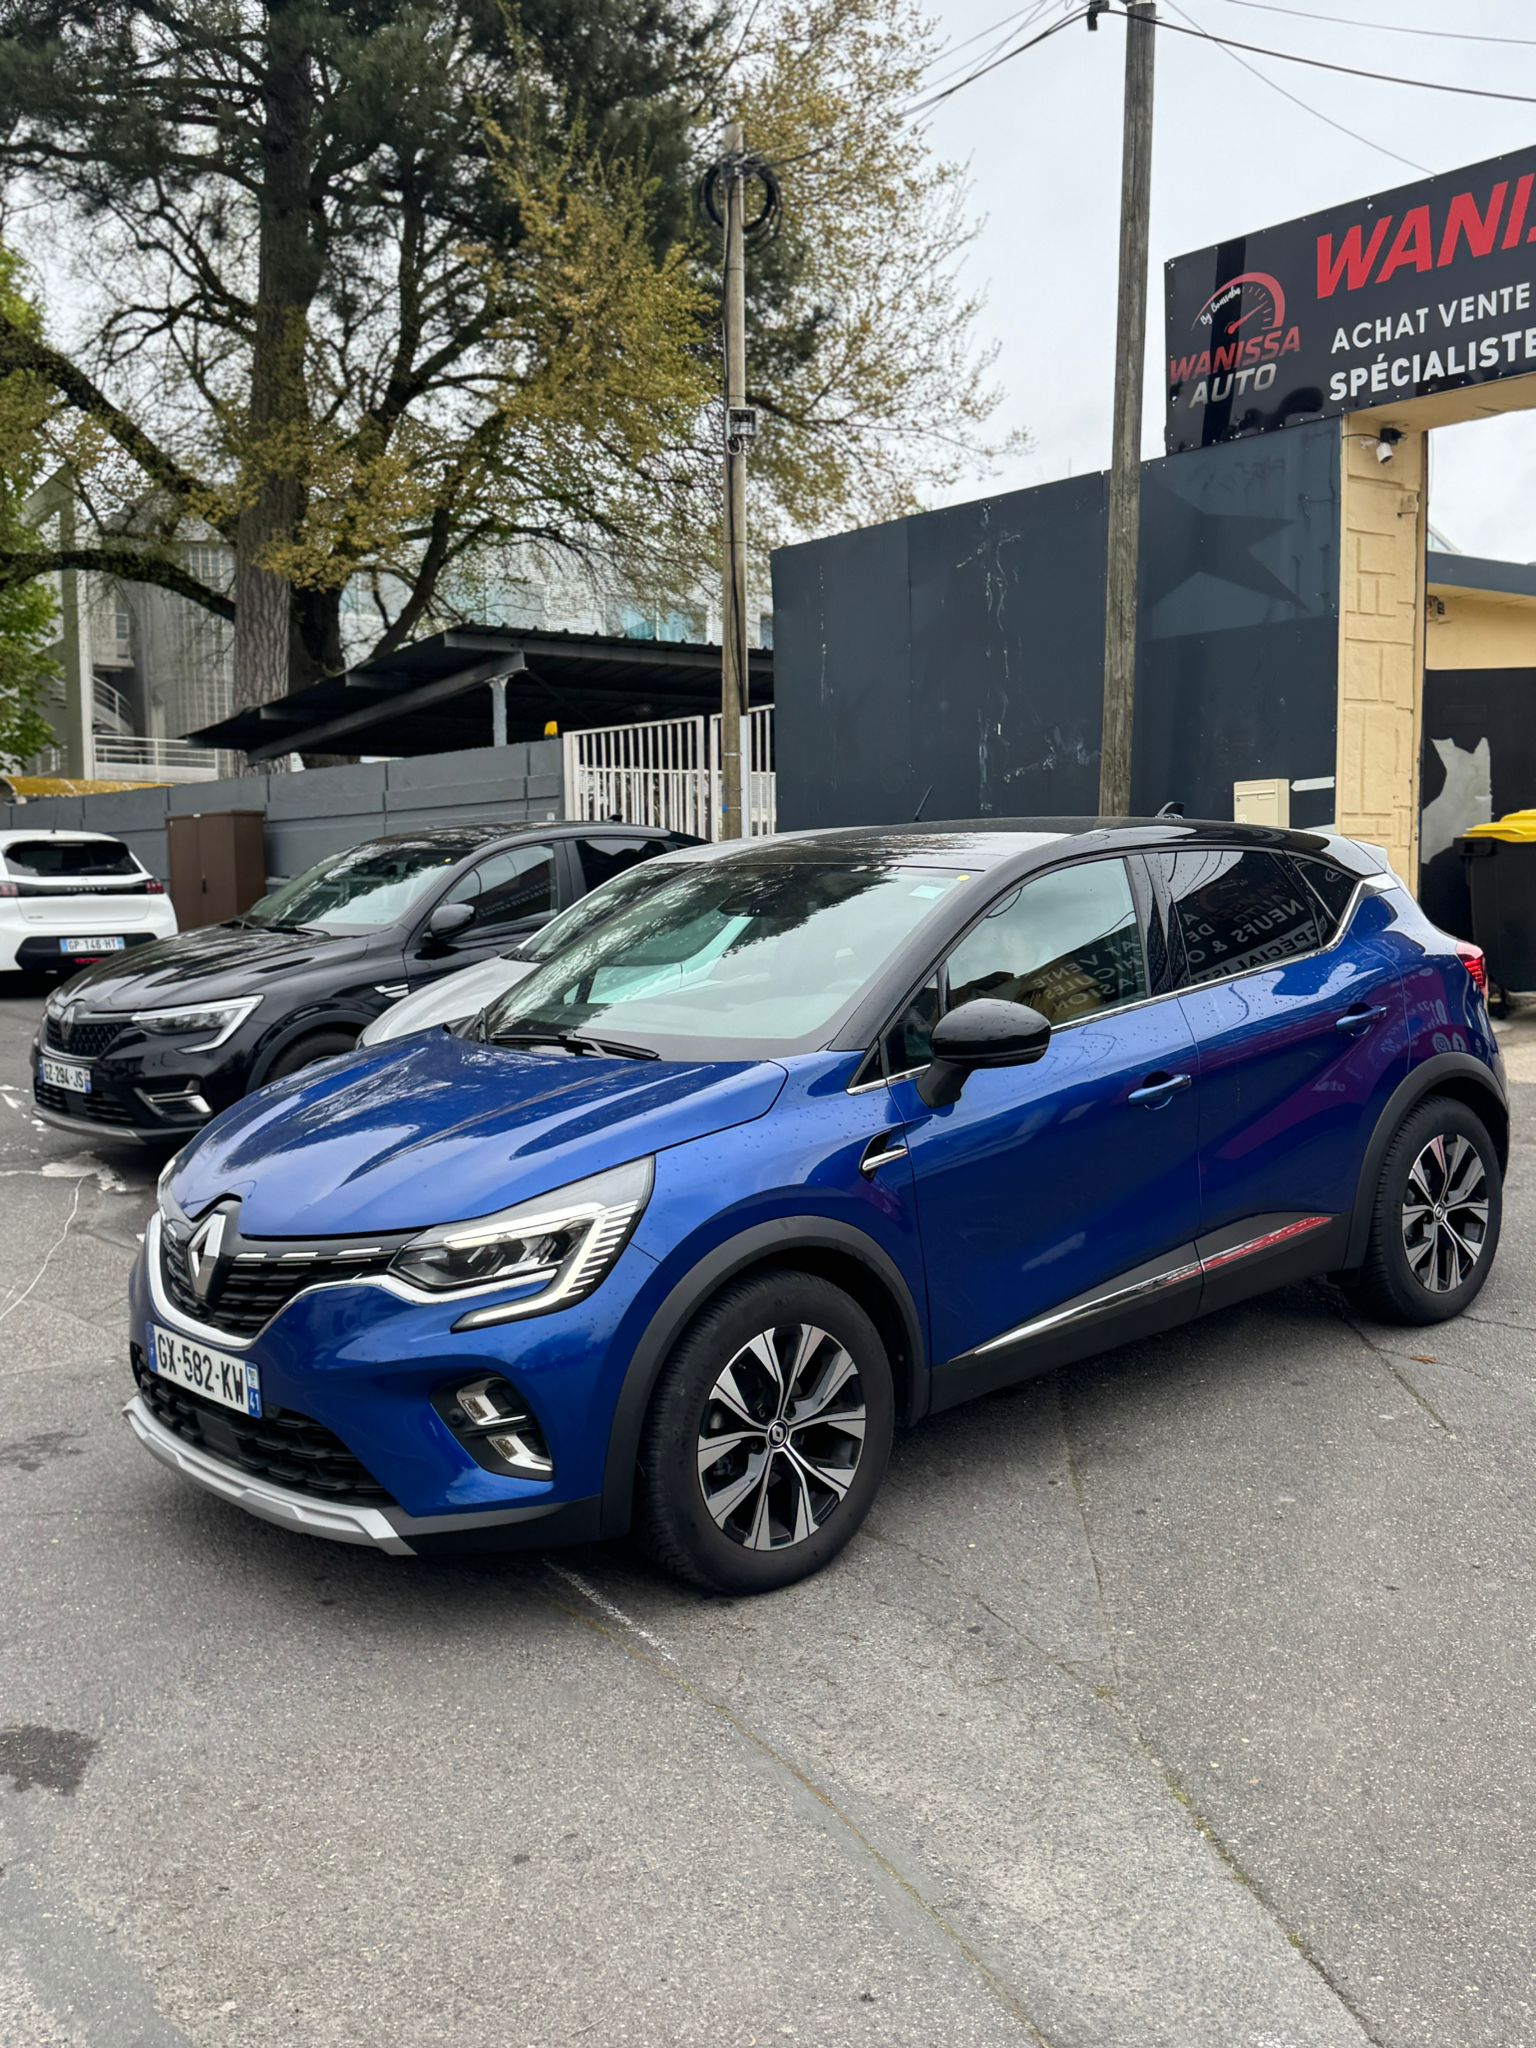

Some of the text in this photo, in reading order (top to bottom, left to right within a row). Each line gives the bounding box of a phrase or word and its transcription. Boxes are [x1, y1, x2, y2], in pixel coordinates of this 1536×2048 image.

[1316, 172, 1536, 299] WANI
[1200, 313, 1213, 325] By
[1331, 282, 1531, 354] ACHAT VENTE
[1170, 326, 1301, 384] WANISSA
[1189, 363, 1277, 409] AUTO
[1329, 328, 1536, 401] SPÉCIALISTE
[157, 1333, 244, 1406] GX-582-KW
[249, 1391, 261, 1412] 41
